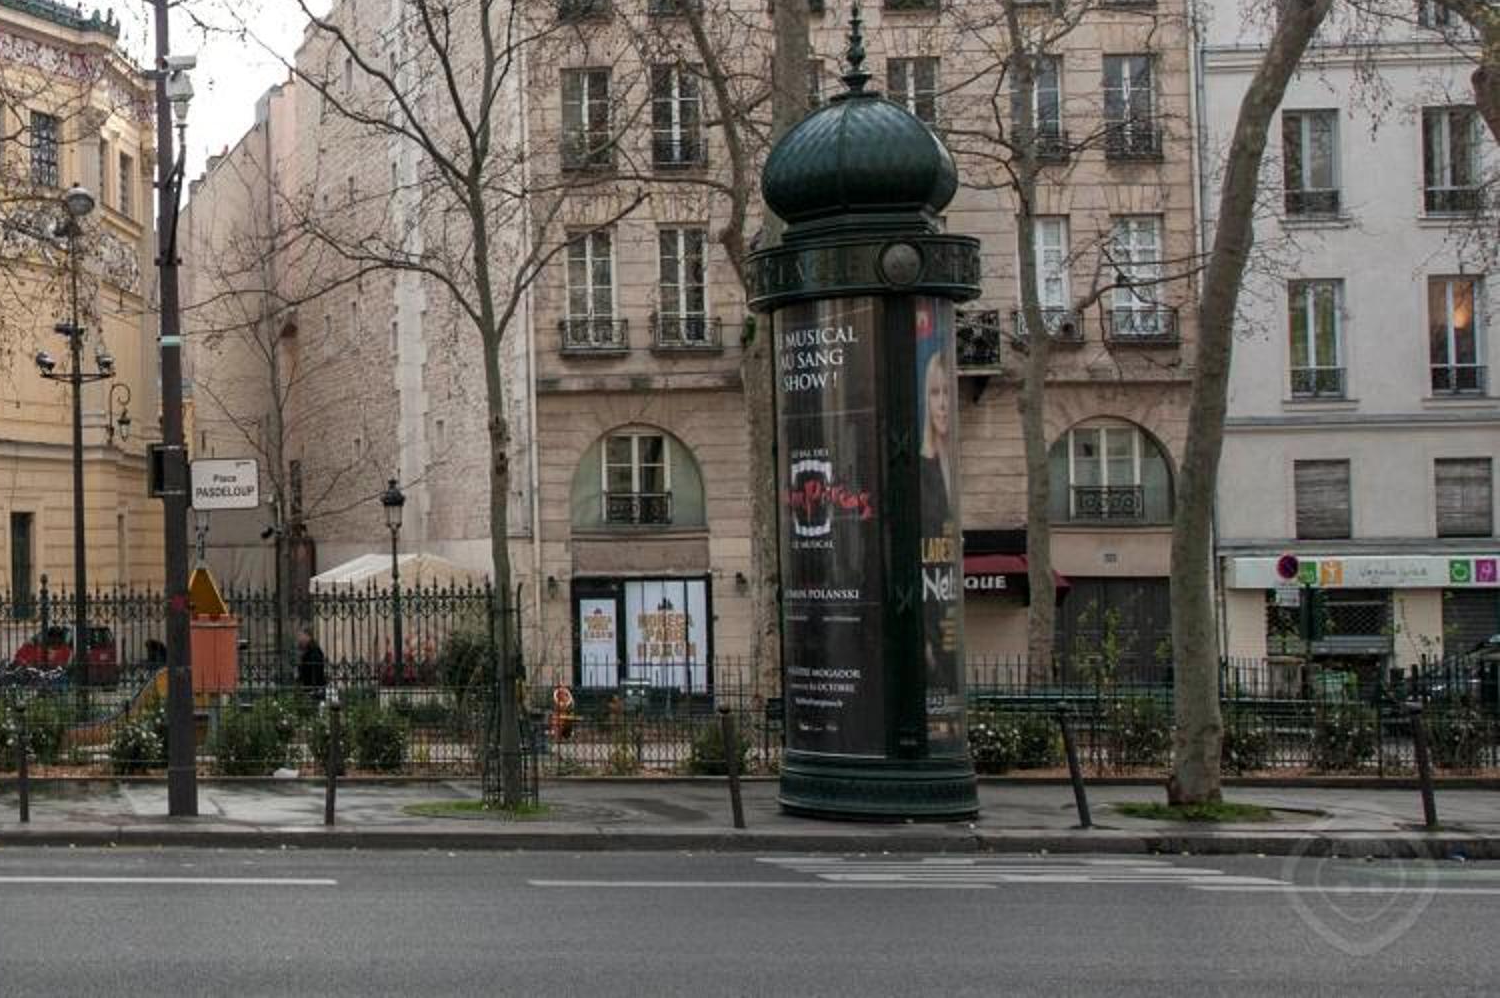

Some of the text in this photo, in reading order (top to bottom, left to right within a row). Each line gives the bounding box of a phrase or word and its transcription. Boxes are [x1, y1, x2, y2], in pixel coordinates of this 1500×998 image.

[784, 325, 859, 348] MUSICAL
[797, 348, 844, 369] SANG
[780, 371, 829, 393] SHOW
